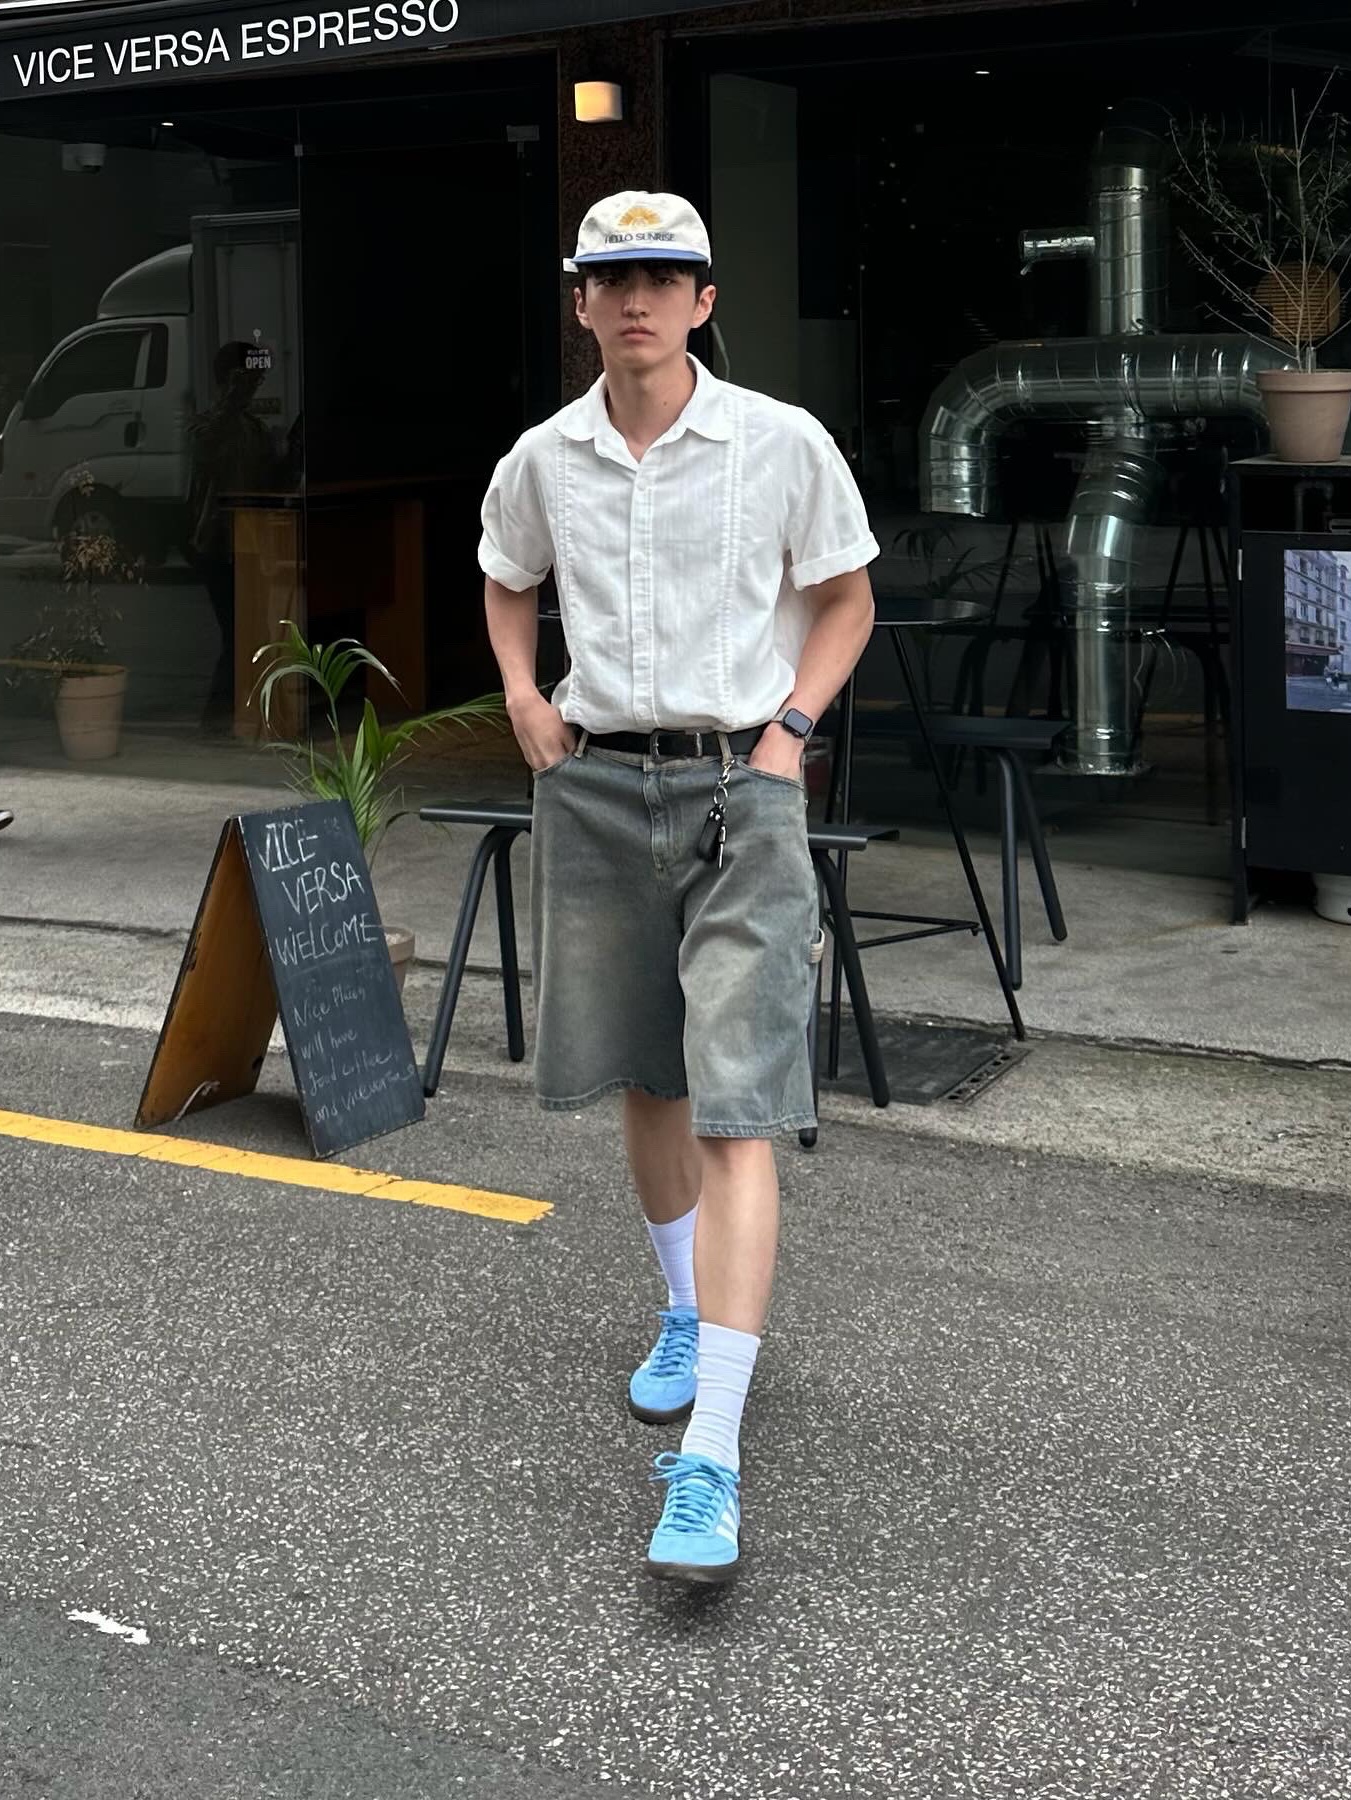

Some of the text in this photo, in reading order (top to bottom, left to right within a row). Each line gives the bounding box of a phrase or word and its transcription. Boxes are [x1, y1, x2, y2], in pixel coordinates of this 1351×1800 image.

[13, 0, 459, 87] VICE VERSA ESPRESSO
[604, 232, 675, 244] HELLO SUNRISE
[245, 356, 271, 369] OPEN
[281, 860, 365, 915] VERSA
[275, 912, 381, 966] WELCOME
